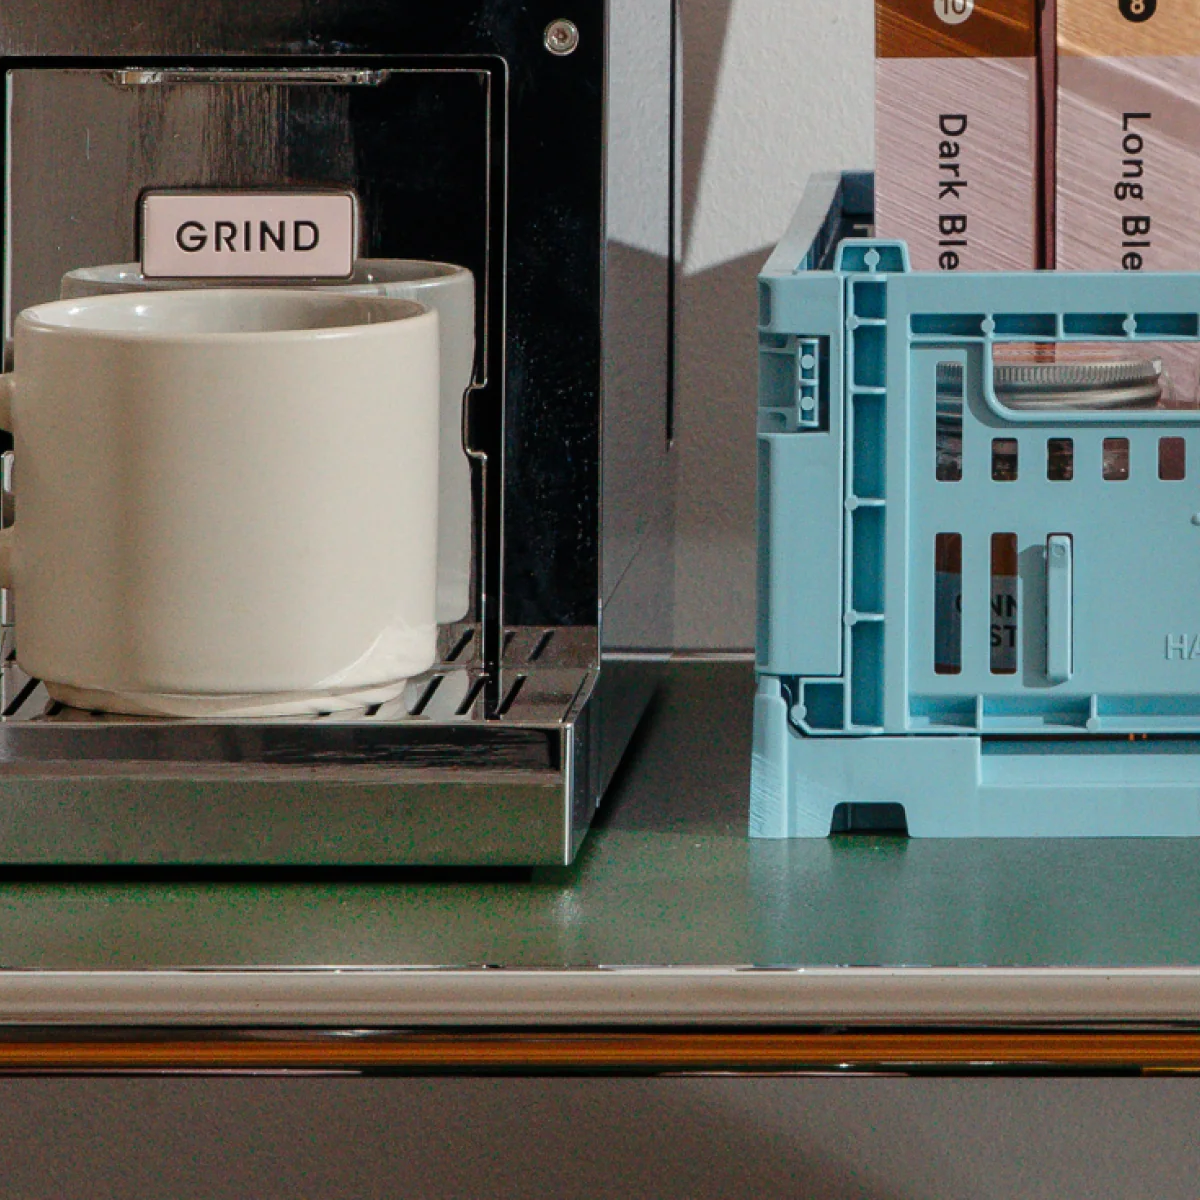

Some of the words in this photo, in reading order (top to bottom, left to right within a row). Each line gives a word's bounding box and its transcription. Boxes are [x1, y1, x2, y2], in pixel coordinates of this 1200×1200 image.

[938, 114, 968, 199] Dark
[1113, 112, 1152, 200] Long
[175, 220, 320, 253] GRIND
